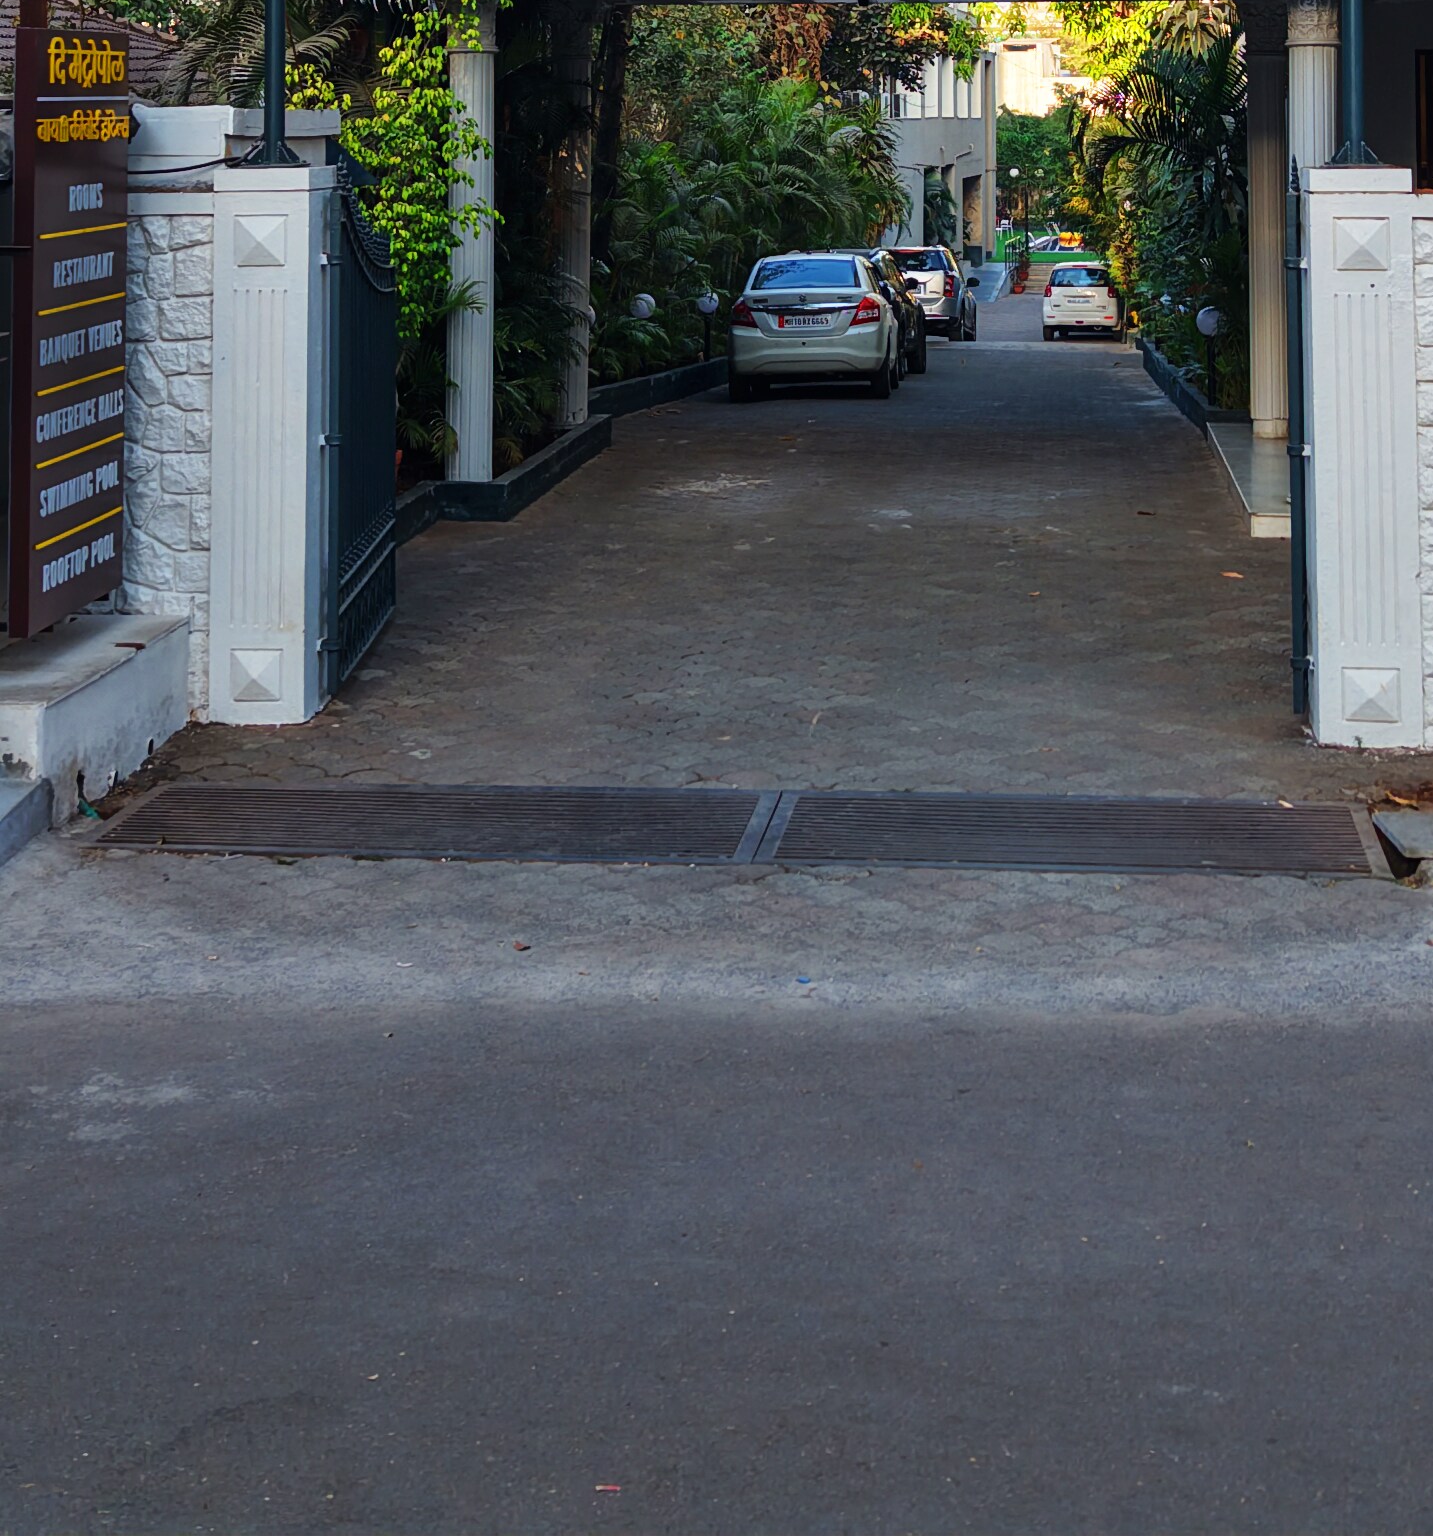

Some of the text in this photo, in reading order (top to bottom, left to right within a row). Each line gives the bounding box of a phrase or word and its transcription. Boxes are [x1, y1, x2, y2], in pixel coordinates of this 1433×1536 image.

[69, 183, 104, 212] ROOMS
[53, 251, 115, 289] RESTAURANT
[39, 320, 123, 366] BANQUET VENUES
[36, 388, 124, 443] CONFERENCE HALLS
[40, 460, 120, 518] SWIMMING POOL
[42, 532, 115, 592] ROOFTOP POOL
